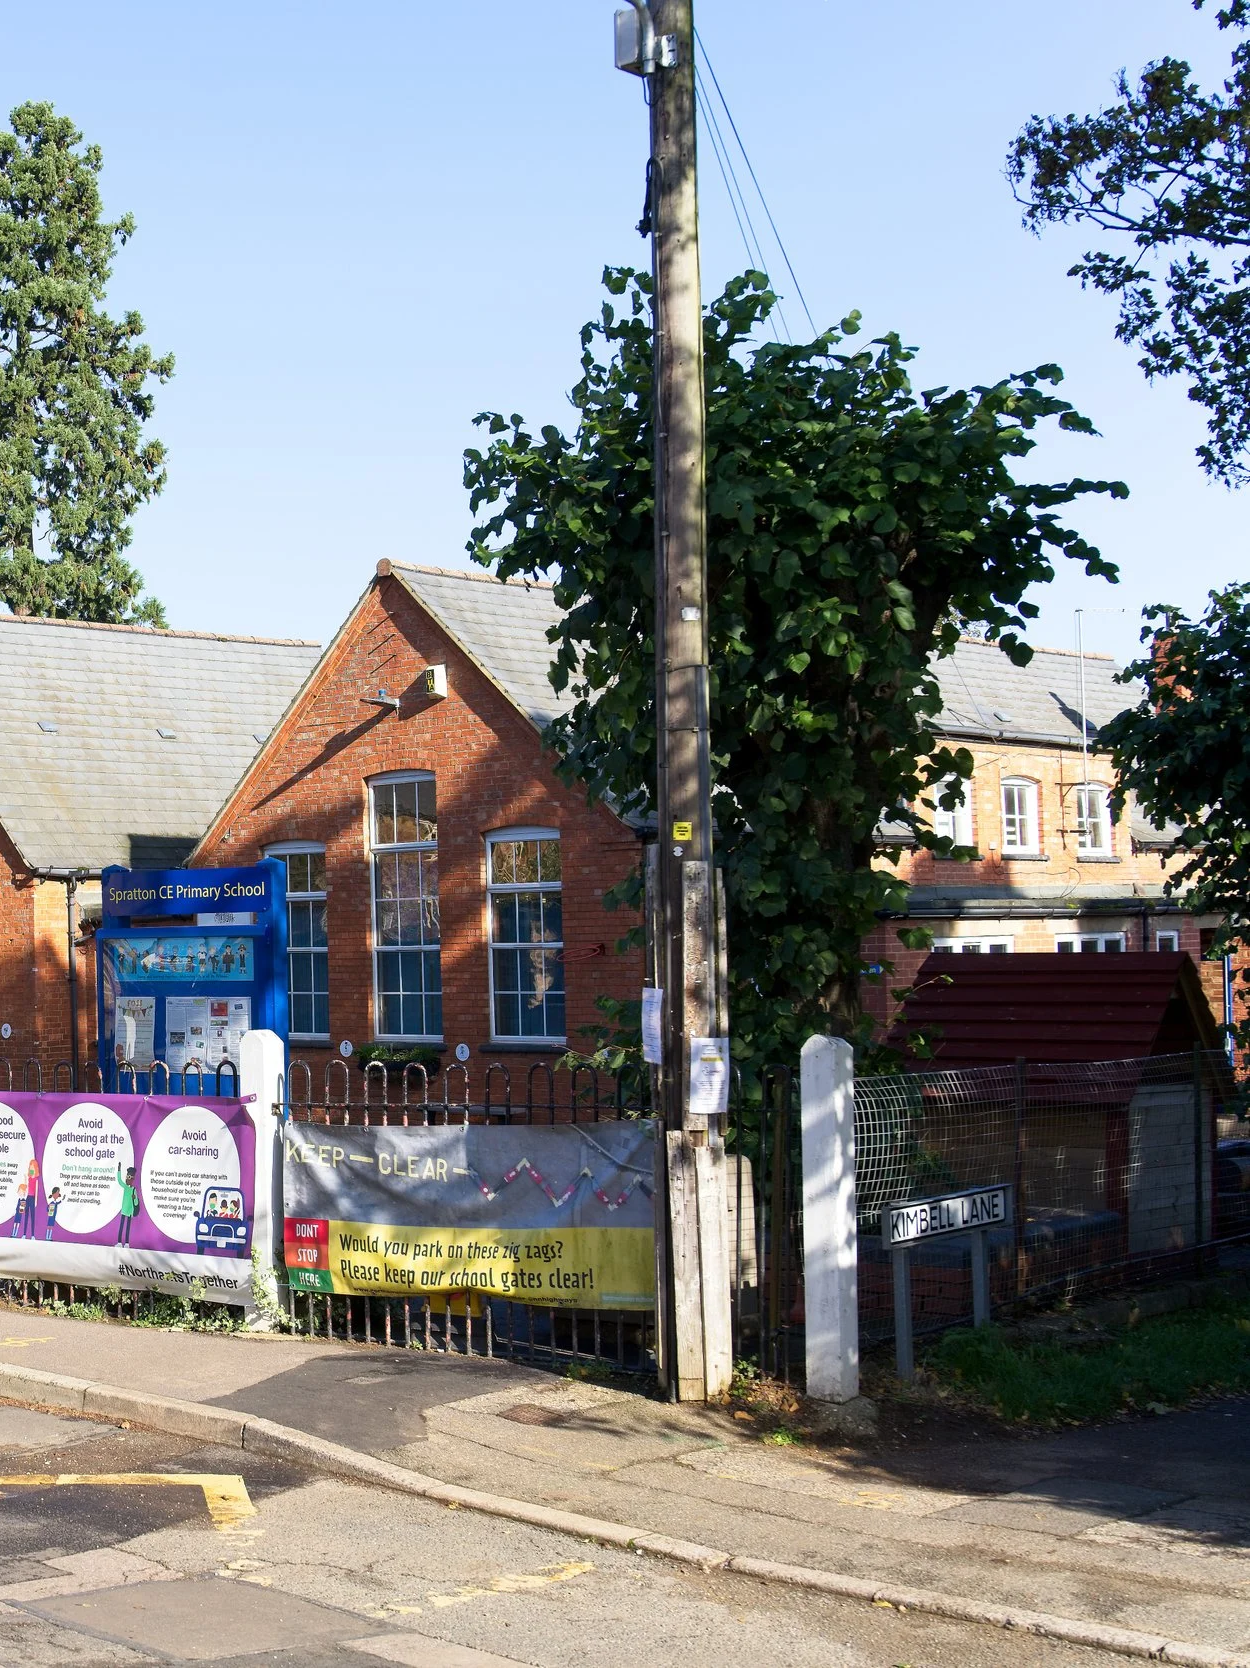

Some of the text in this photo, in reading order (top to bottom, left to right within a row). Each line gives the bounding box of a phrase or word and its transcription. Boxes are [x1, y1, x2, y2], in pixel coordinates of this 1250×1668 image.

[109, 881, 265, 904] Spratton CE Primary School
[78, 1117, 103, 1129] Avoid
[56, 1132, 125, 1146] gathering at the
[181, 1129, 207, 1141] Avoid
[64, 1146, 116, 1160] school gate
[168, 1144, 219, 1160] car-sharing
[285, 1139, 448, 1183] KEEP CLEAR
[7, 1169, 18, 1177] your
[62, 1164, 116, 1174] Don't hang around!
[59, 1172, 71, 1180] Drop
[98, 1174, 116, 1182] children
[154, 1170, 165, 1178] you
[164, 1170, 178, 1178] can't
[177, 1171, 192, 1179] avoid
[200, 1172, 218, 1181] sharing
[79, 1181, 92, 1189] leave
[150, 1177, 202, 1188] those outside of your
[151, 1186, 178, 1194] household
[184, 1187, 202, 1196] bubble
[153, 1194, 168, 1202] make
[179, 1196, 196, 1204] you're
[157, 1203, 178, 1212] wearing
[181, 1204, 193, 1212] face
[162, 1212, 187, 1221] covering!
[891, 1193, 1000, 1240] KIMBELL LANE
[295, 1223, 319, 1239] DONT
[339, 1233, 564, 1263] Would you park on these zig zags?
[297, 1248, 318, 1263] STOP
[298, 1271, 321, 1287] HERE
[340, 1259, 594, 1292] Please keep our school gates clear!
